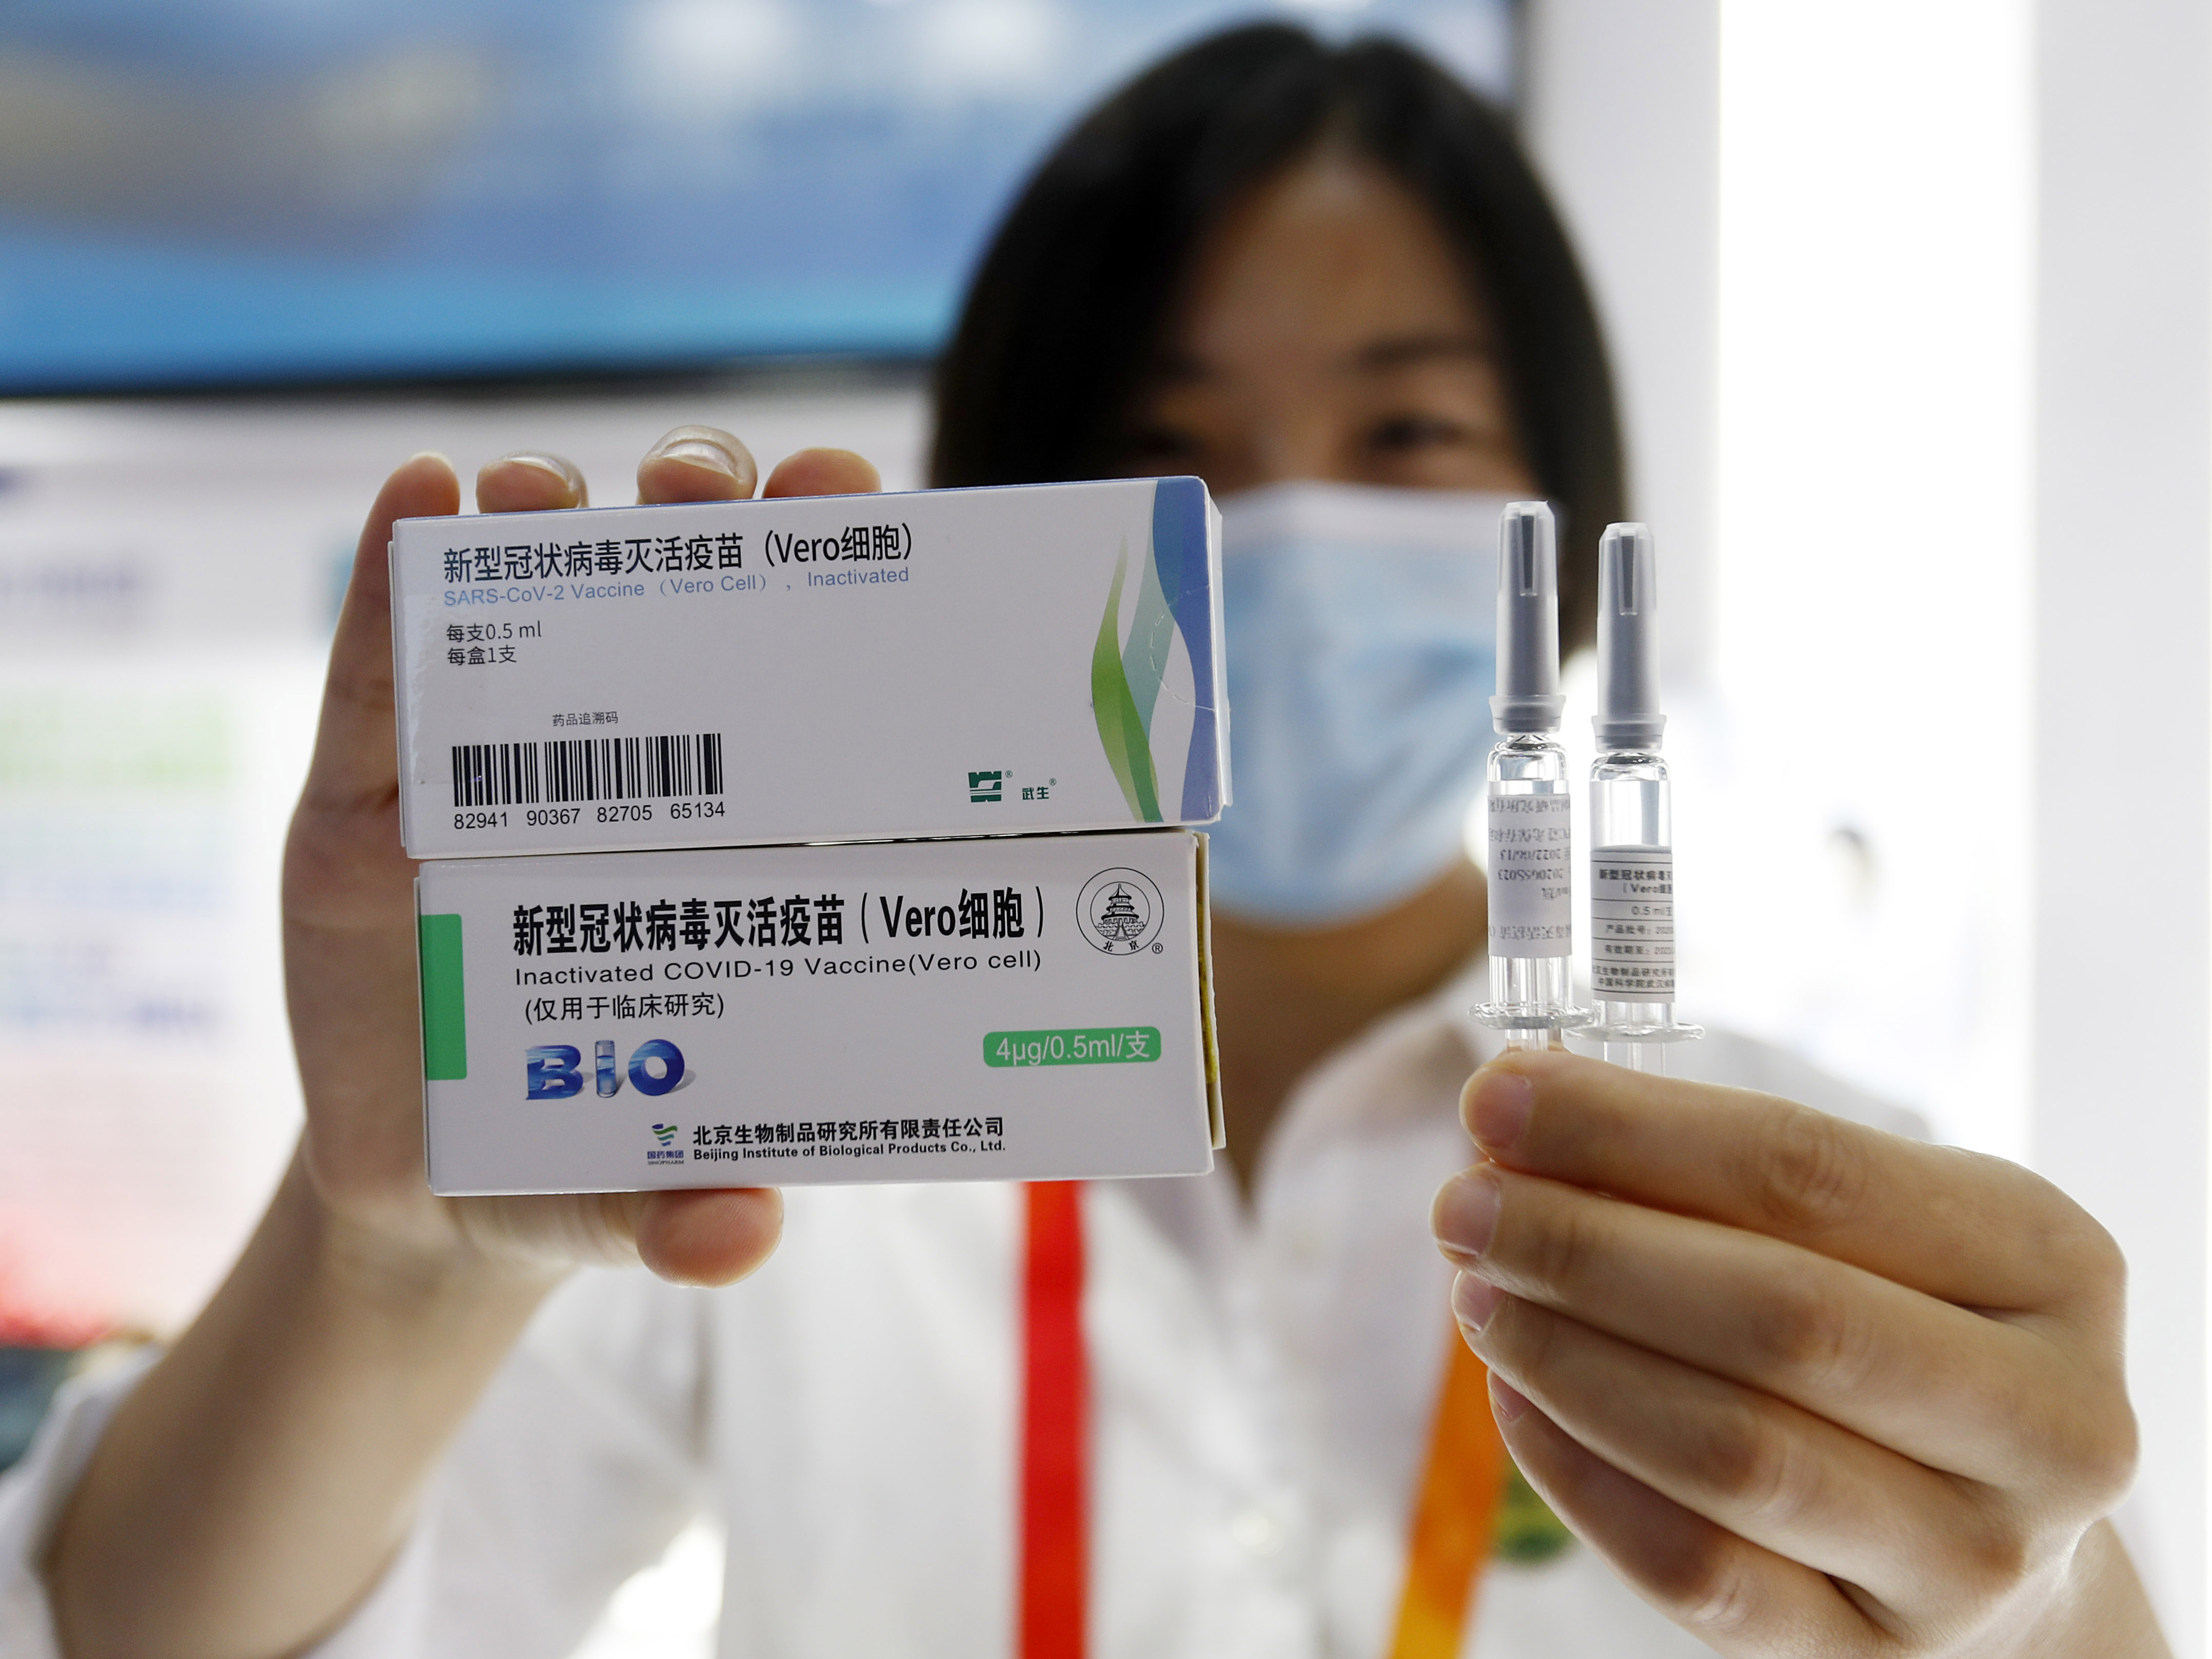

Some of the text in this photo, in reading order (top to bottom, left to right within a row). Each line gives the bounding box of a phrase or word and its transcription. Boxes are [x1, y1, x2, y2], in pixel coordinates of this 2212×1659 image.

[444, 585, 564, 606] SARS-CoV-2
[570, 582, 644, 599] Vaccine
[808, 566, 908, 587] Inactivated
[446, 620, 541, 643] 每支0.5 ml
[447, 644, 517, 666] 每盒1支
[552, 711, 618, 727] 药品追溯码
[454, 801, 725, 830] 82941 90367 82705 65134
[516, 950, 1041, 985] Inactivated COVID-19 Vaccine(Vero cell)
[525, 992, 724, 1025] (仅用于临床研究)
[693, 1117, 1004, 1145] 北京生物制品研究所有限责任公司
[694, 1139, 1005, 1162] Beijing Institute of Biological Products Co., Ltd.
